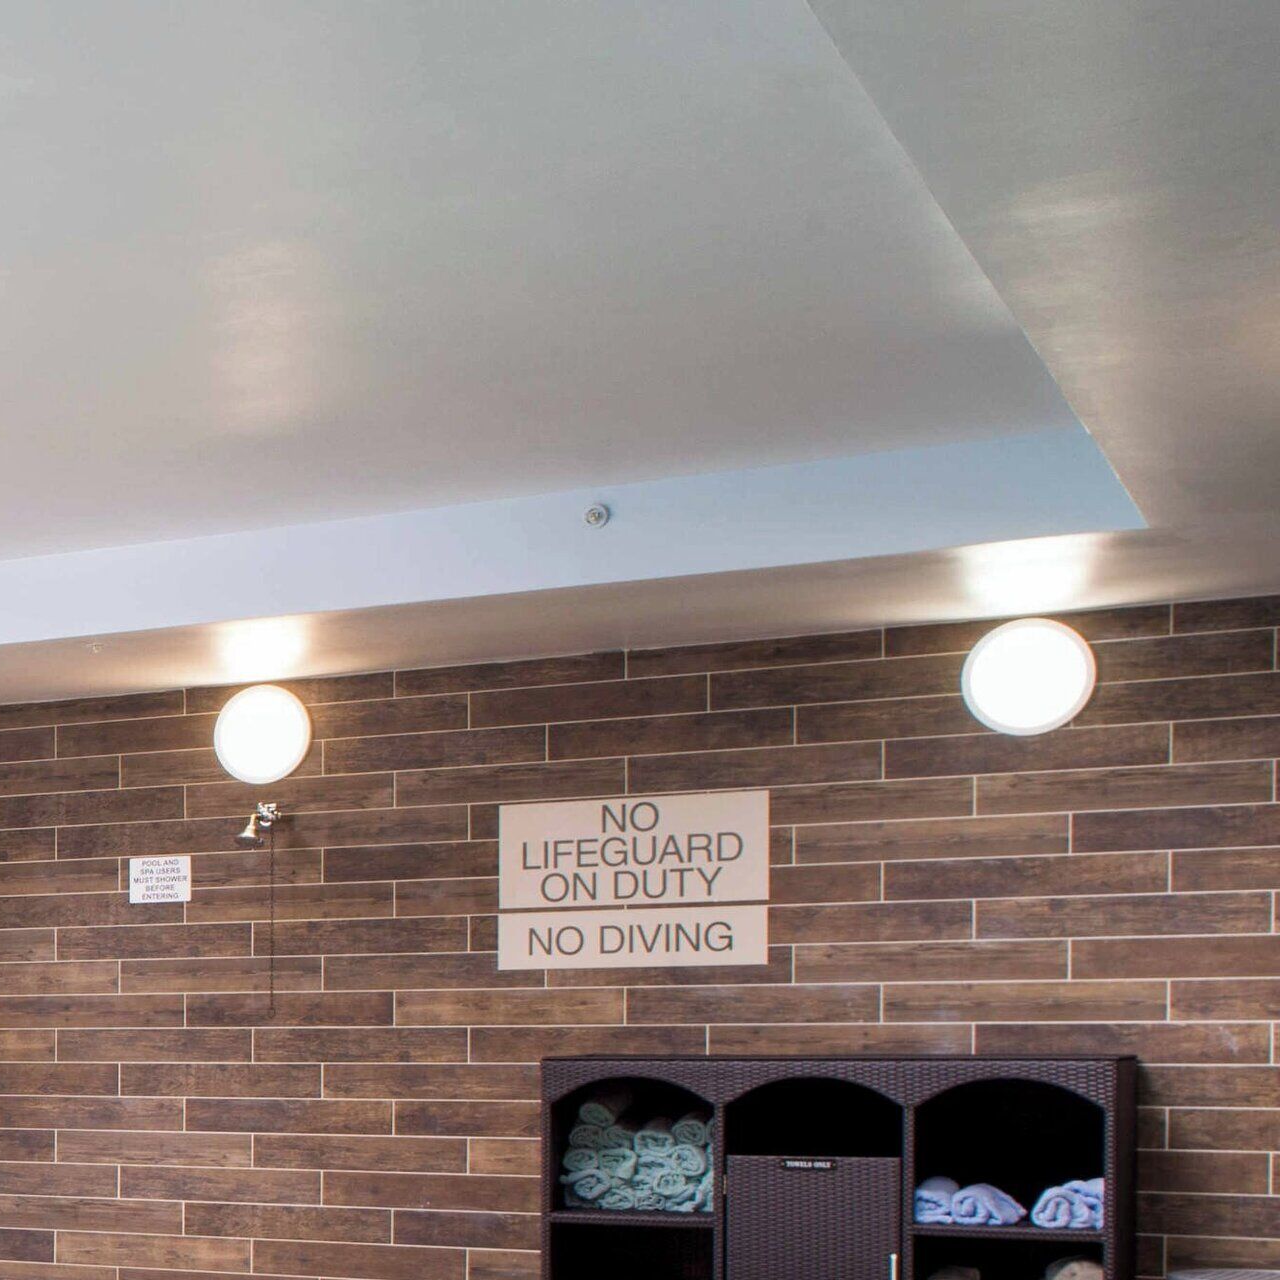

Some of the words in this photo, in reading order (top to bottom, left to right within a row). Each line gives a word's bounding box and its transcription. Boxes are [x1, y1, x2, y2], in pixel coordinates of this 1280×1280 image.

[601, 801, 659, 833] NO
[142, 859, 162, 867] POOL
[522, 831, 744, 870] LIFEGUARD
[133, 876, 153, 884] MUST
[155, 875, 188, 883] SHOWER
[145, 884, 175, 892] BEFORE
[540, 871, 597, 903] ON
[613, 866, 723, 900] DUTY
[528, 925, 584, 956] NO
[600, 921, 734, 954] DIVING
